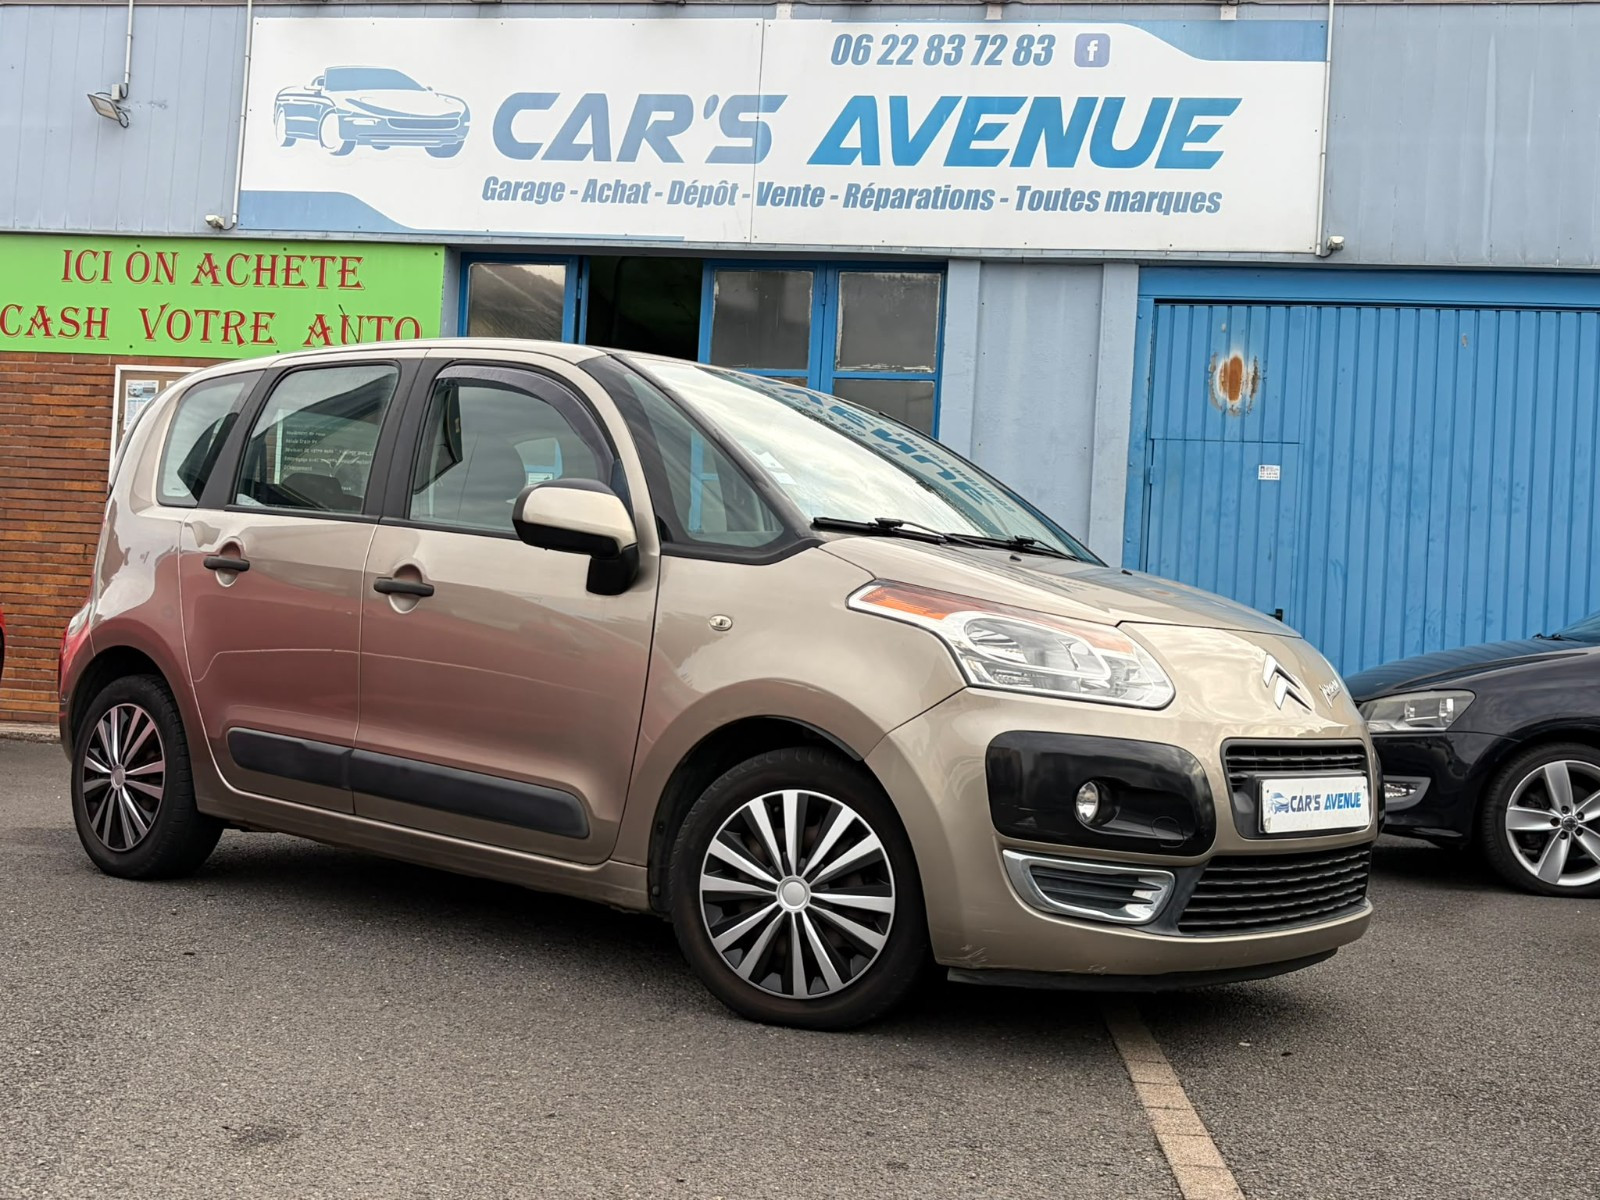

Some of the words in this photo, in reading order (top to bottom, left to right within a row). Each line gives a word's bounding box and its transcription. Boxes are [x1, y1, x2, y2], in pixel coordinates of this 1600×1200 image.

[831, 34, 874, 67] 06
[876, 34, 917, 67] 22
[922, 34, 966, 67] 83
[970, 34, 1005, 67] 72
[1012, 34, 1057, 68] 83
[492, 92, 789, 165] CAR'S
[806, 95, 1243, 169] AVENUE
[482, 175, 566, 203] Garage
[581, 178, 651, 204] Achat
[667, 180, 739, 208] Dépôt
[757, 182, 825, 208] Vente
[843, 182, 995, 212] Réparations
[1015, 186, 1101, 212] Toutes
[1104, 190, 1223, 216] marques
[62, 249, 113, 284] ICI
[125, 251, 179, 285] ON
[191, 252, 365, 290] ACHETE
[0, 303, 110, 339] CASH
[138, 302, 277, 347] VOTRE
[302, 313, 423, 347] AUTO
[1290, 795, 1321, 812] CAR'S
[1324, 792, 1362, 810] AVENUE
